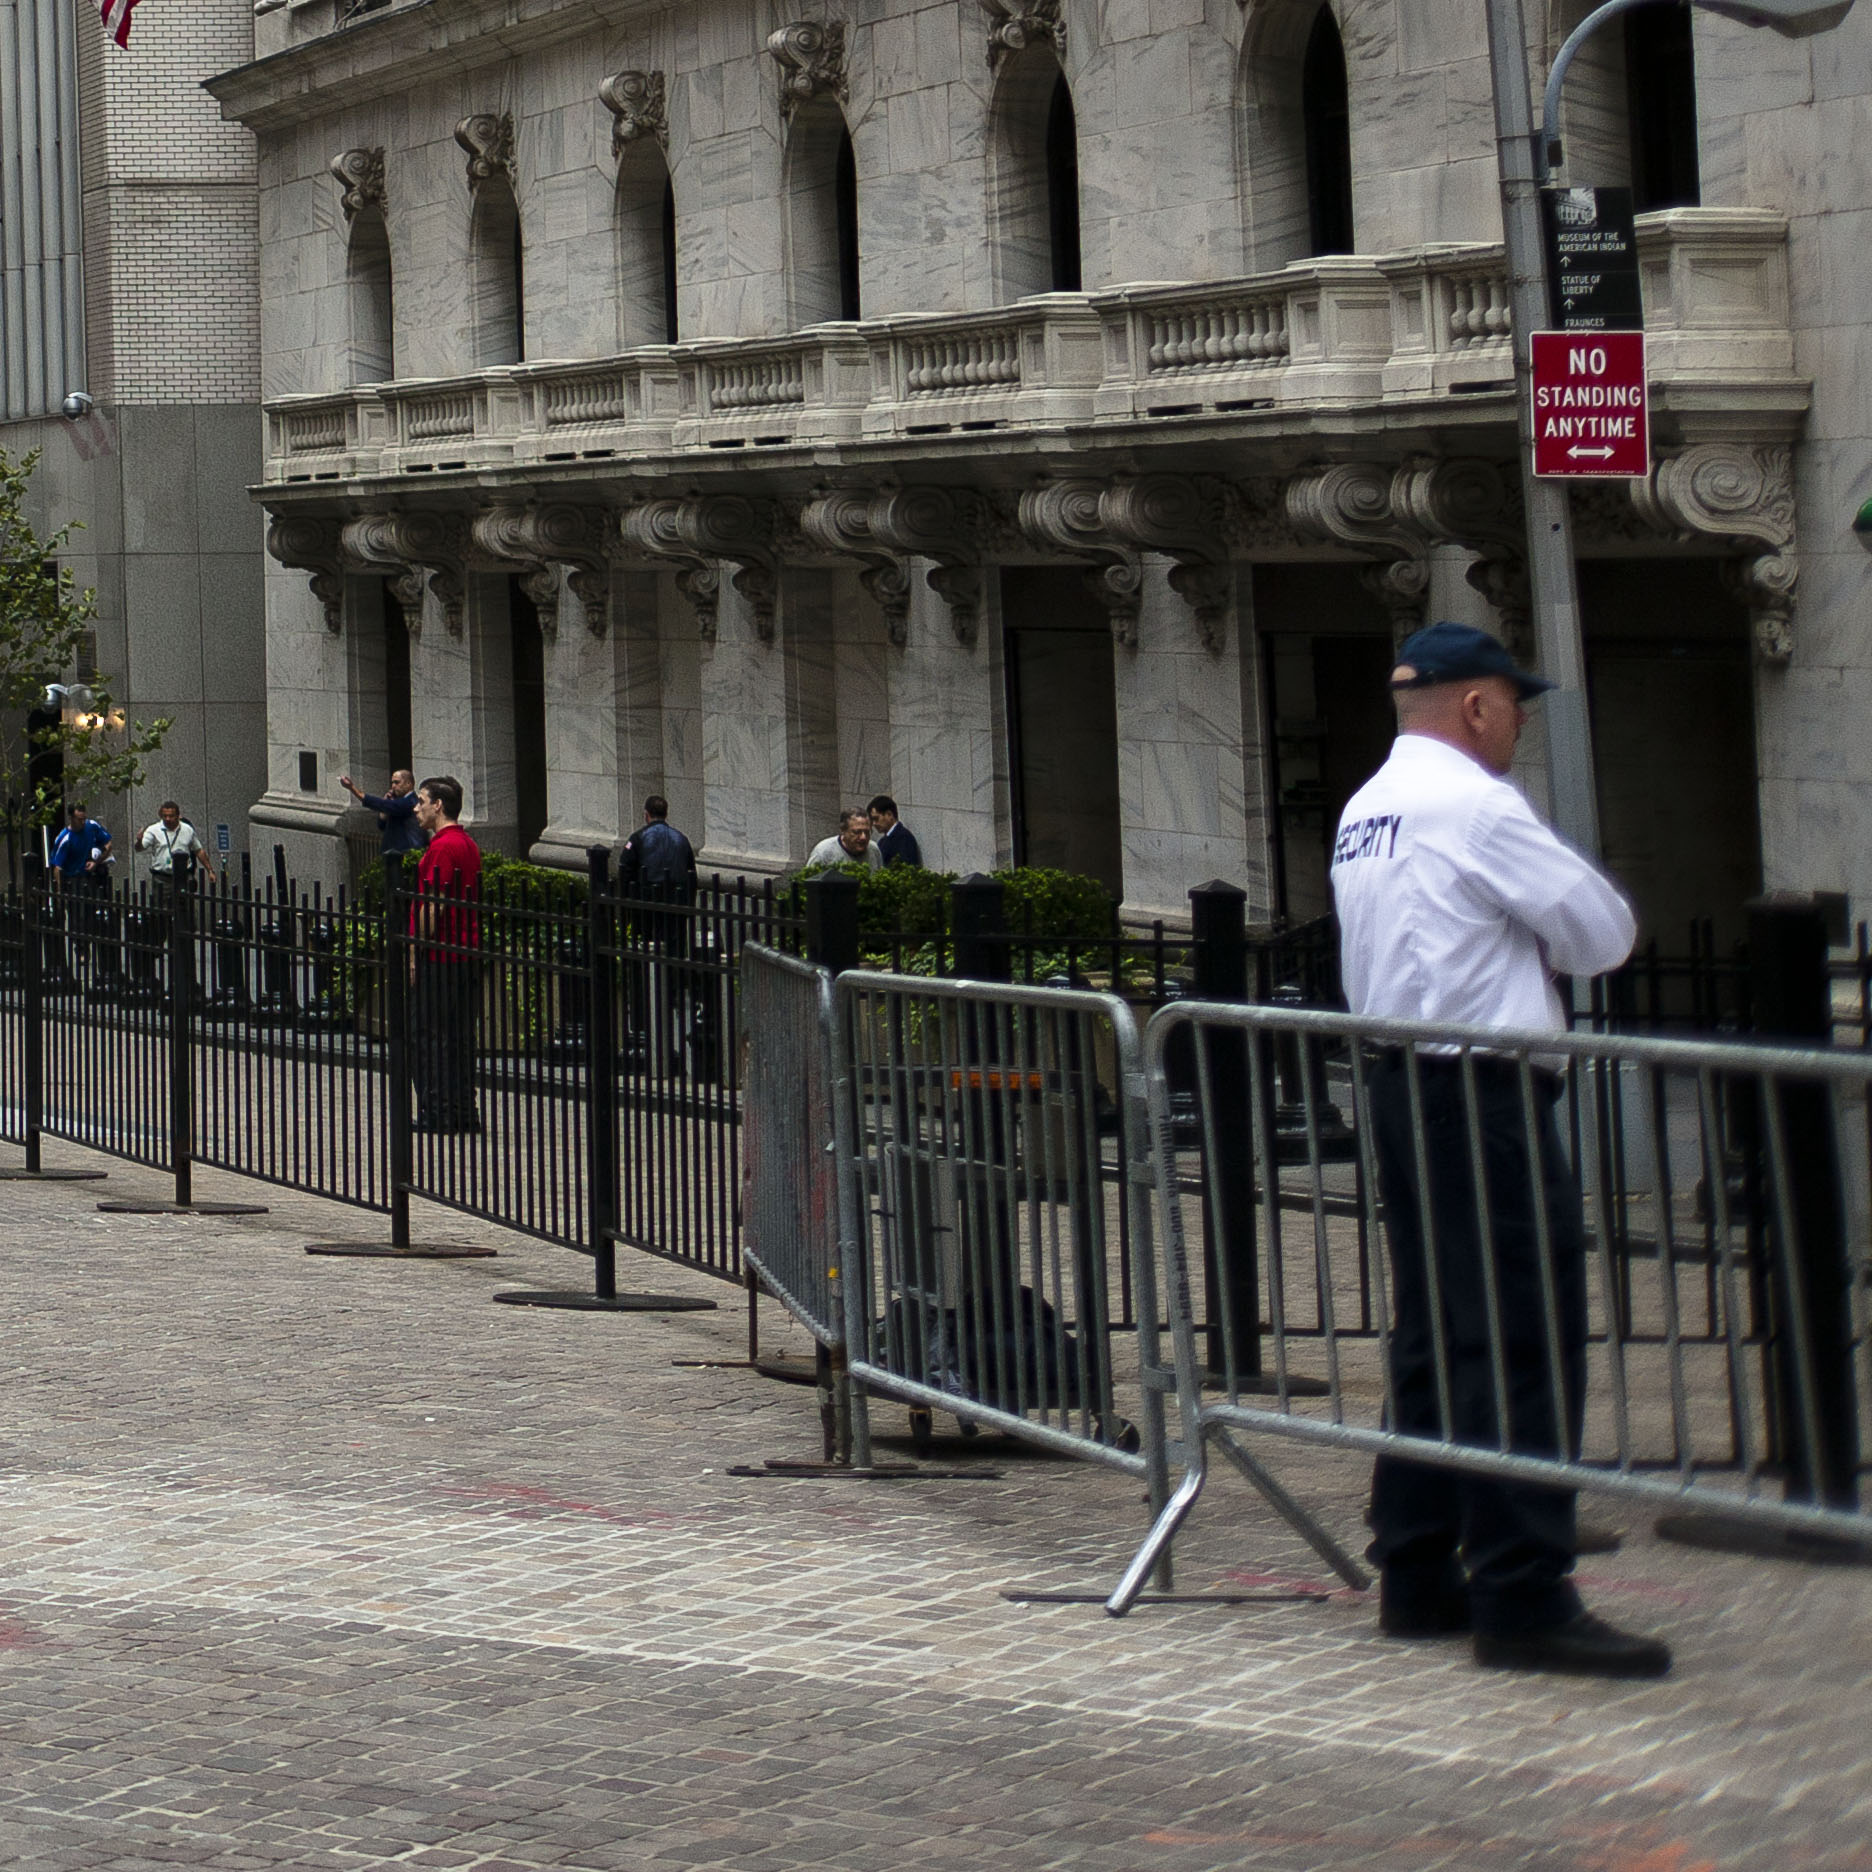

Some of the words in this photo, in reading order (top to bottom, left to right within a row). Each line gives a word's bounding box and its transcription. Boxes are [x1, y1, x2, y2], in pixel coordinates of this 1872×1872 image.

[1557, 232, 1591, 242] MUSEUM
[1591, 232, 1602, 241] OF
[1603, 231, 1620, 241] THE
[1558, 242, 1598, 252] AMERICAN
[1599, 241, 1626, 251] INDIAN
[1561, 275, 1589, 285] STATUE
[1591, 275, 1601, 284] OF
[1562, 285, 1595, 295] LIBERTY
[1565, 317, 1605, 328] FRAUNCES
[1569, 348, 1607, 375] NO
[1537, 386, 1642, 408] STANDING
[1544, 416, 1637, 438] ANYTIME
